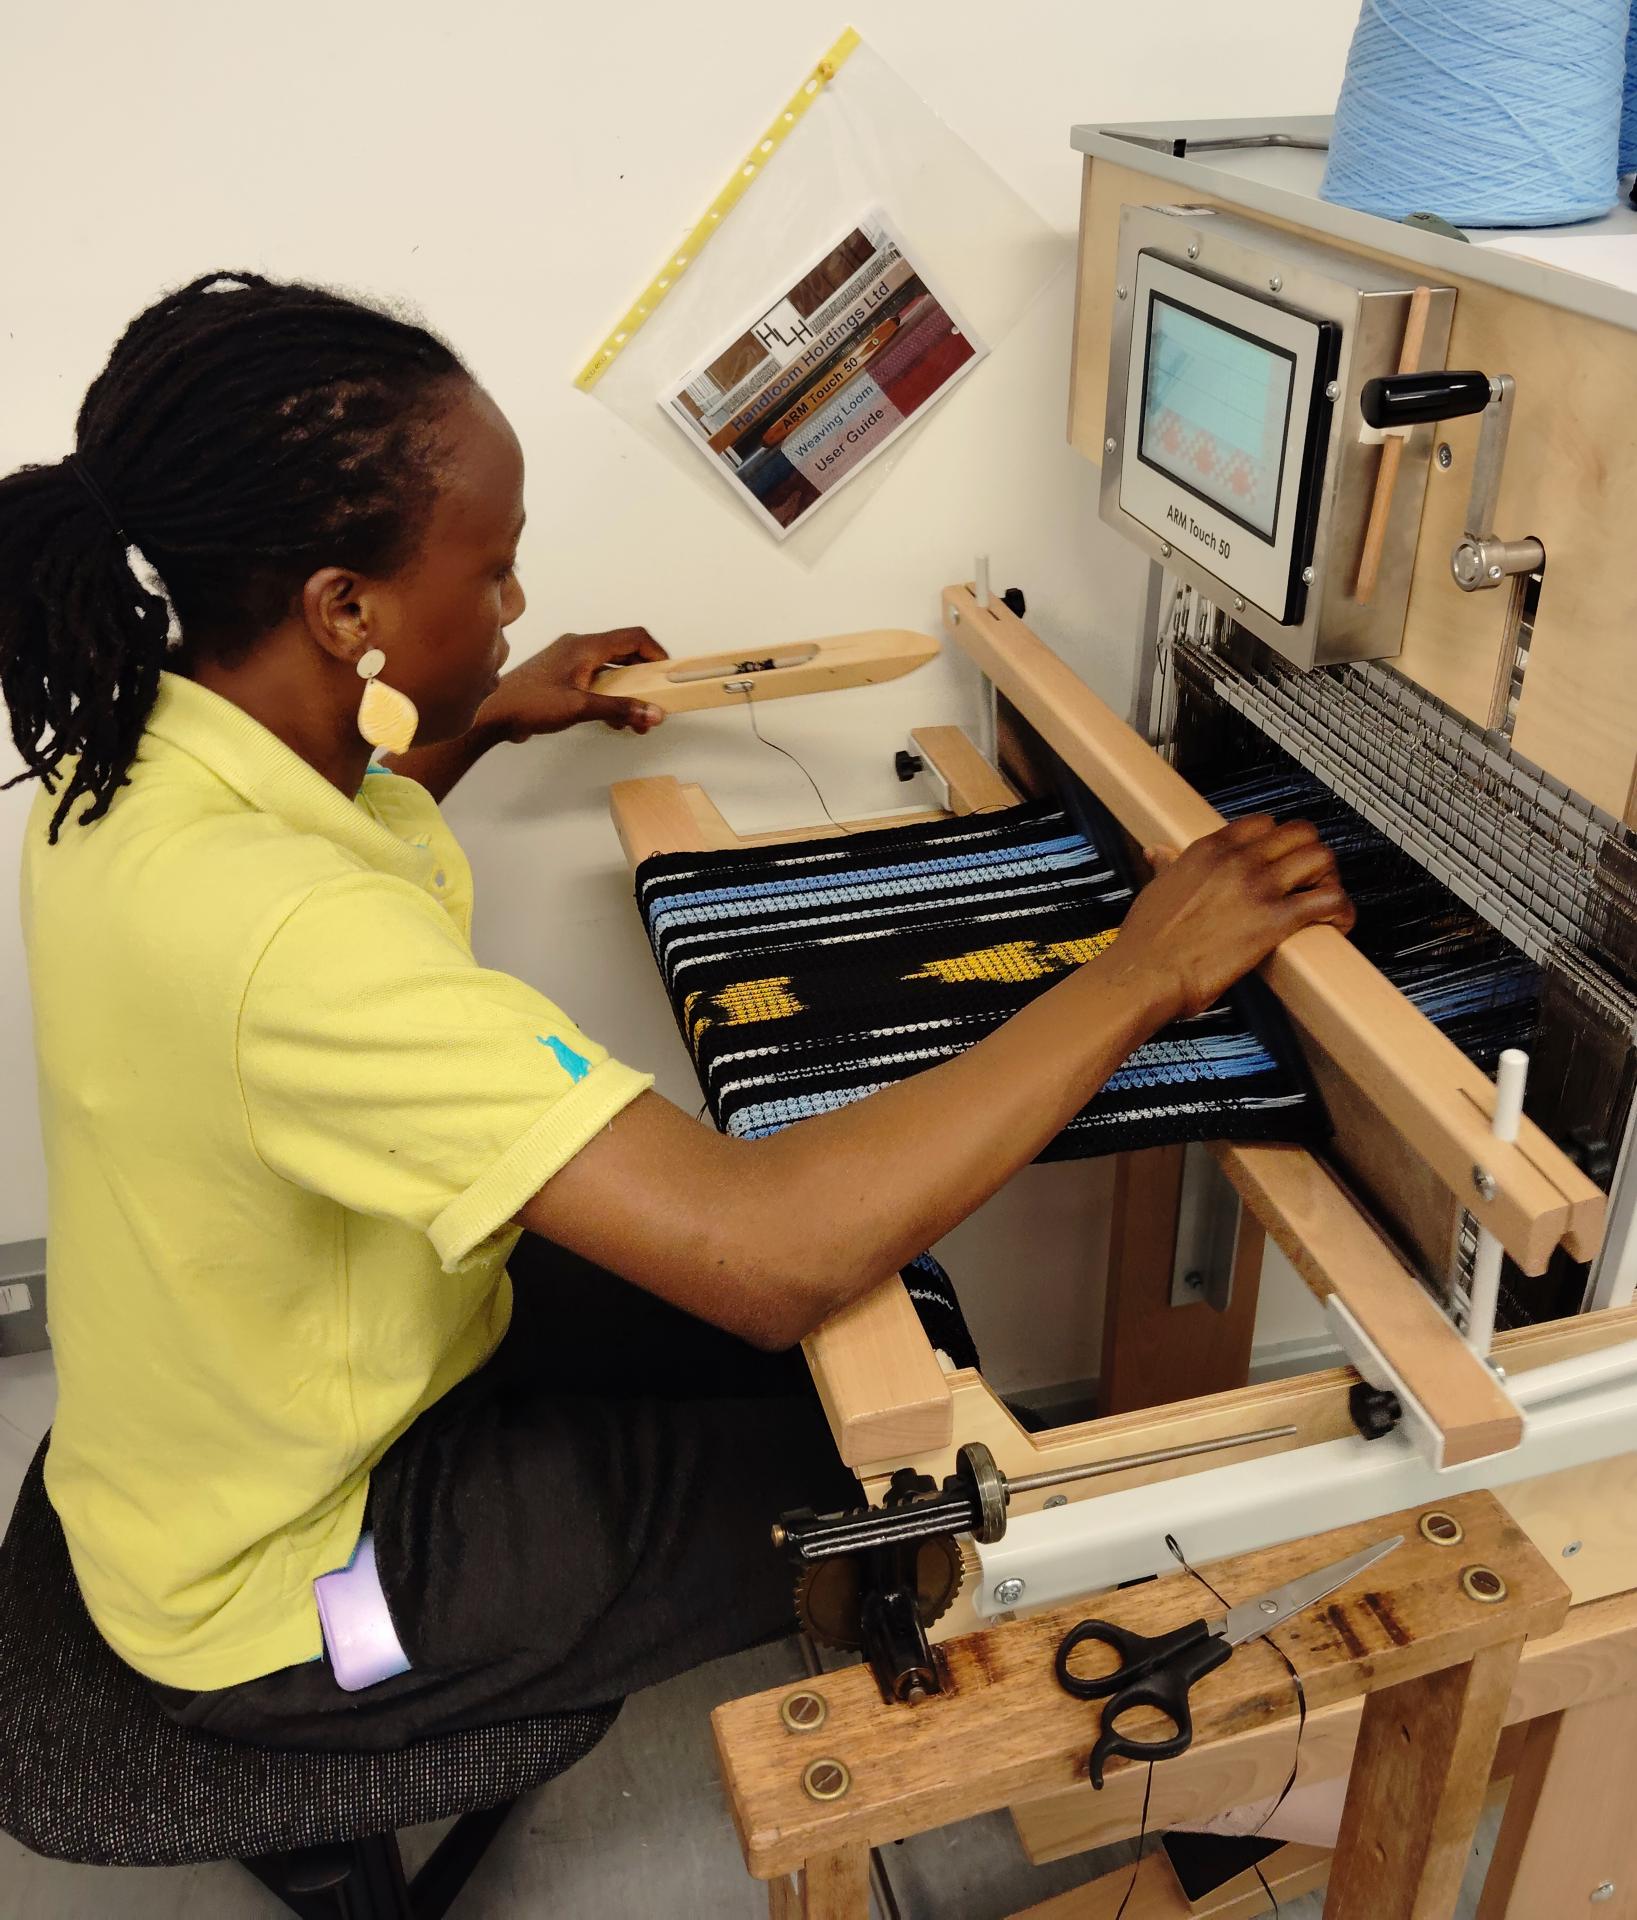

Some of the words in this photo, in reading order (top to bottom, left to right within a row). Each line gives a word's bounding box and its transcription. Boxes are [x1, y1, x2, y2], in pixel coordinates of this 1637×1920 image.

[731, 366, 803, 432] Handloom
[801, 307, 865, 367] Holdings
[863, 280, 890, 309] Ltd
[755, 319, 814, 349] HLH
[783, 402, 809, 430] ARM
[809, 372, 844, 404] Touch
[843, 357, 858, 373] 50
[795, 414, 844, 457] Weaving
[841, 385, 874, 416] Loom
[815, 442, 846, 472] User
[846, 409, 885, 444] Guide
[1167, 504, 1187, 530] ARM
[1189, 517, 1217, 551] Touch
[1218, 539, 1231, 559] 50
